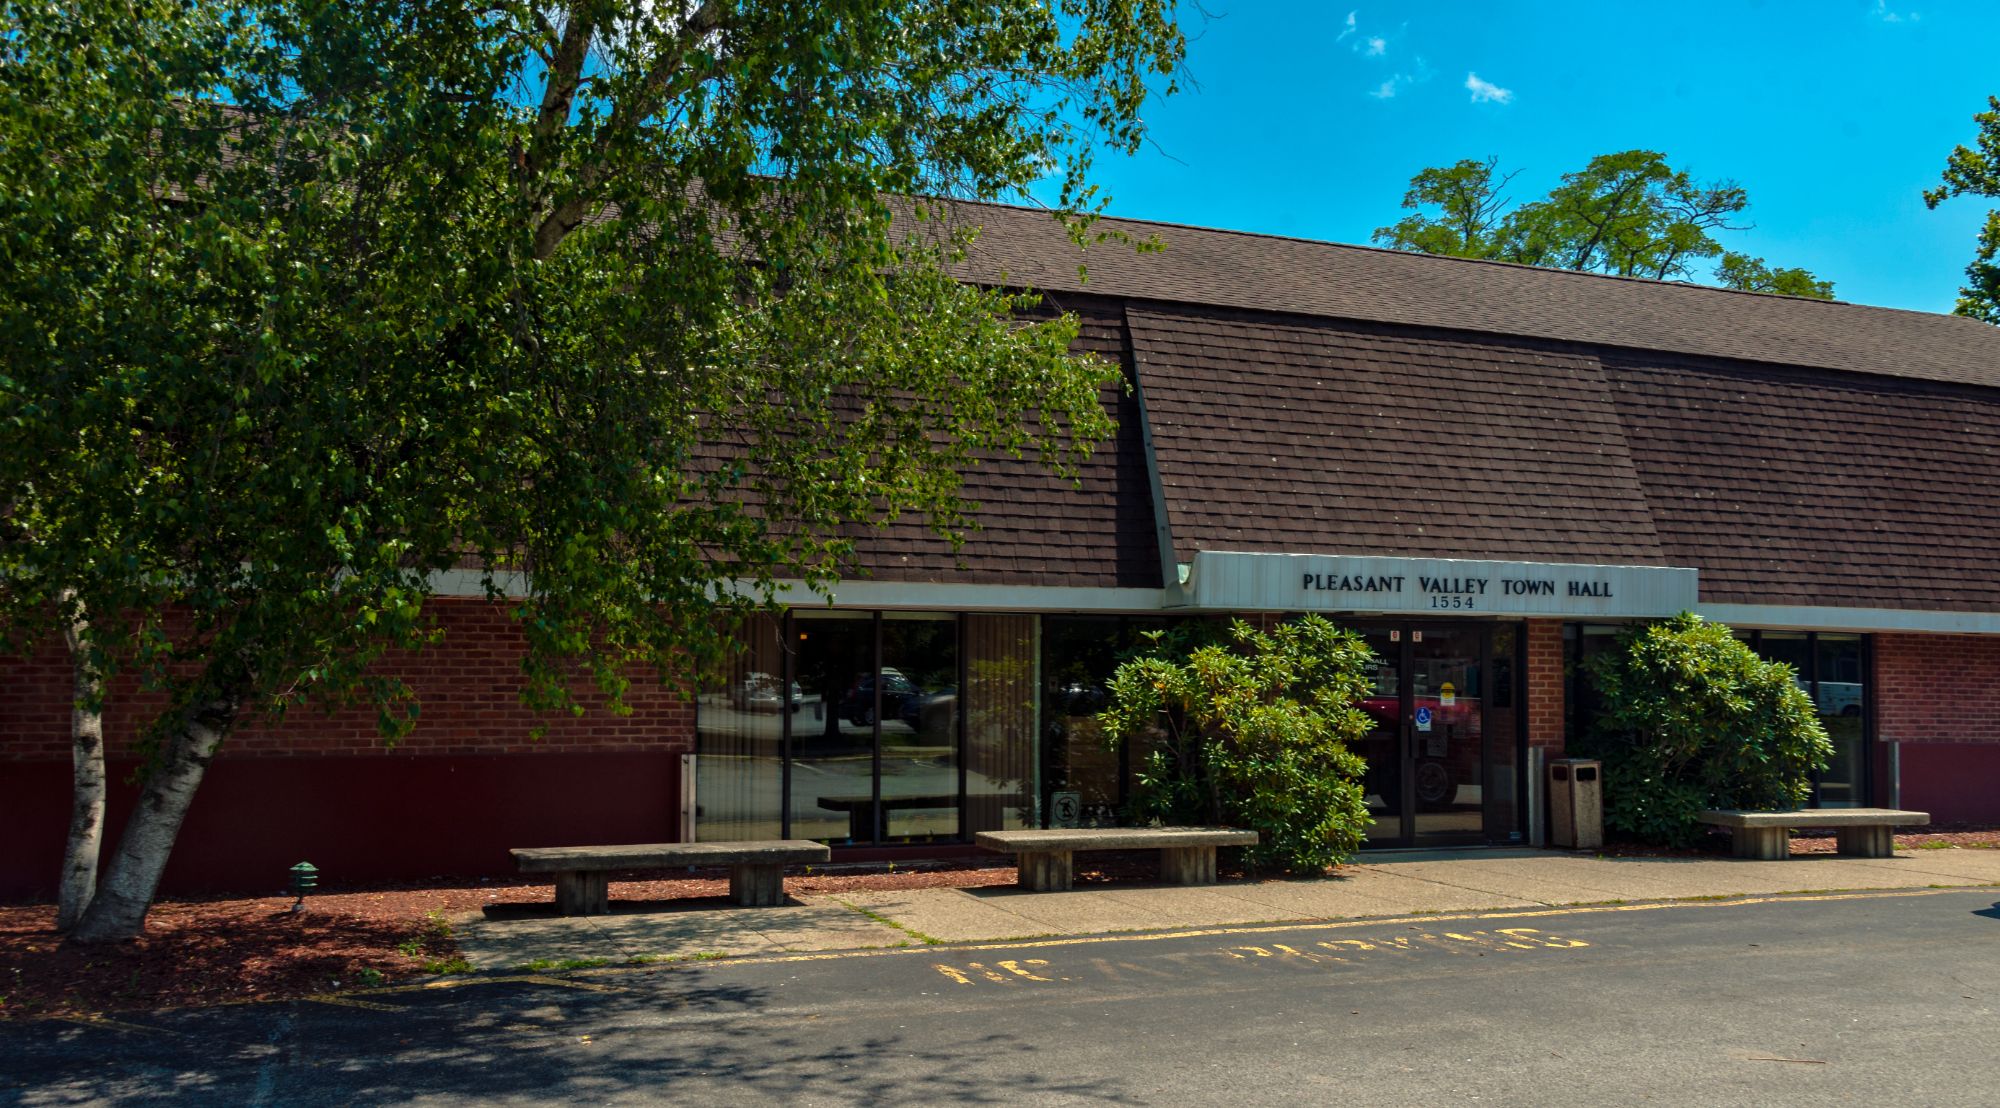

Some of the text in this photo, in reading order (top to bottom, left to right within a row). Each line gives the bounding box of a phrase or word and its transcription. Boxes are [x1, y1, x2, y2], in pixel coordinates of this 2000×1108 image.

[1303, 574, 1613, 597] PLEASANT VALLEY TOWN HALL
[1431, 596, 1474, 608] 1554
